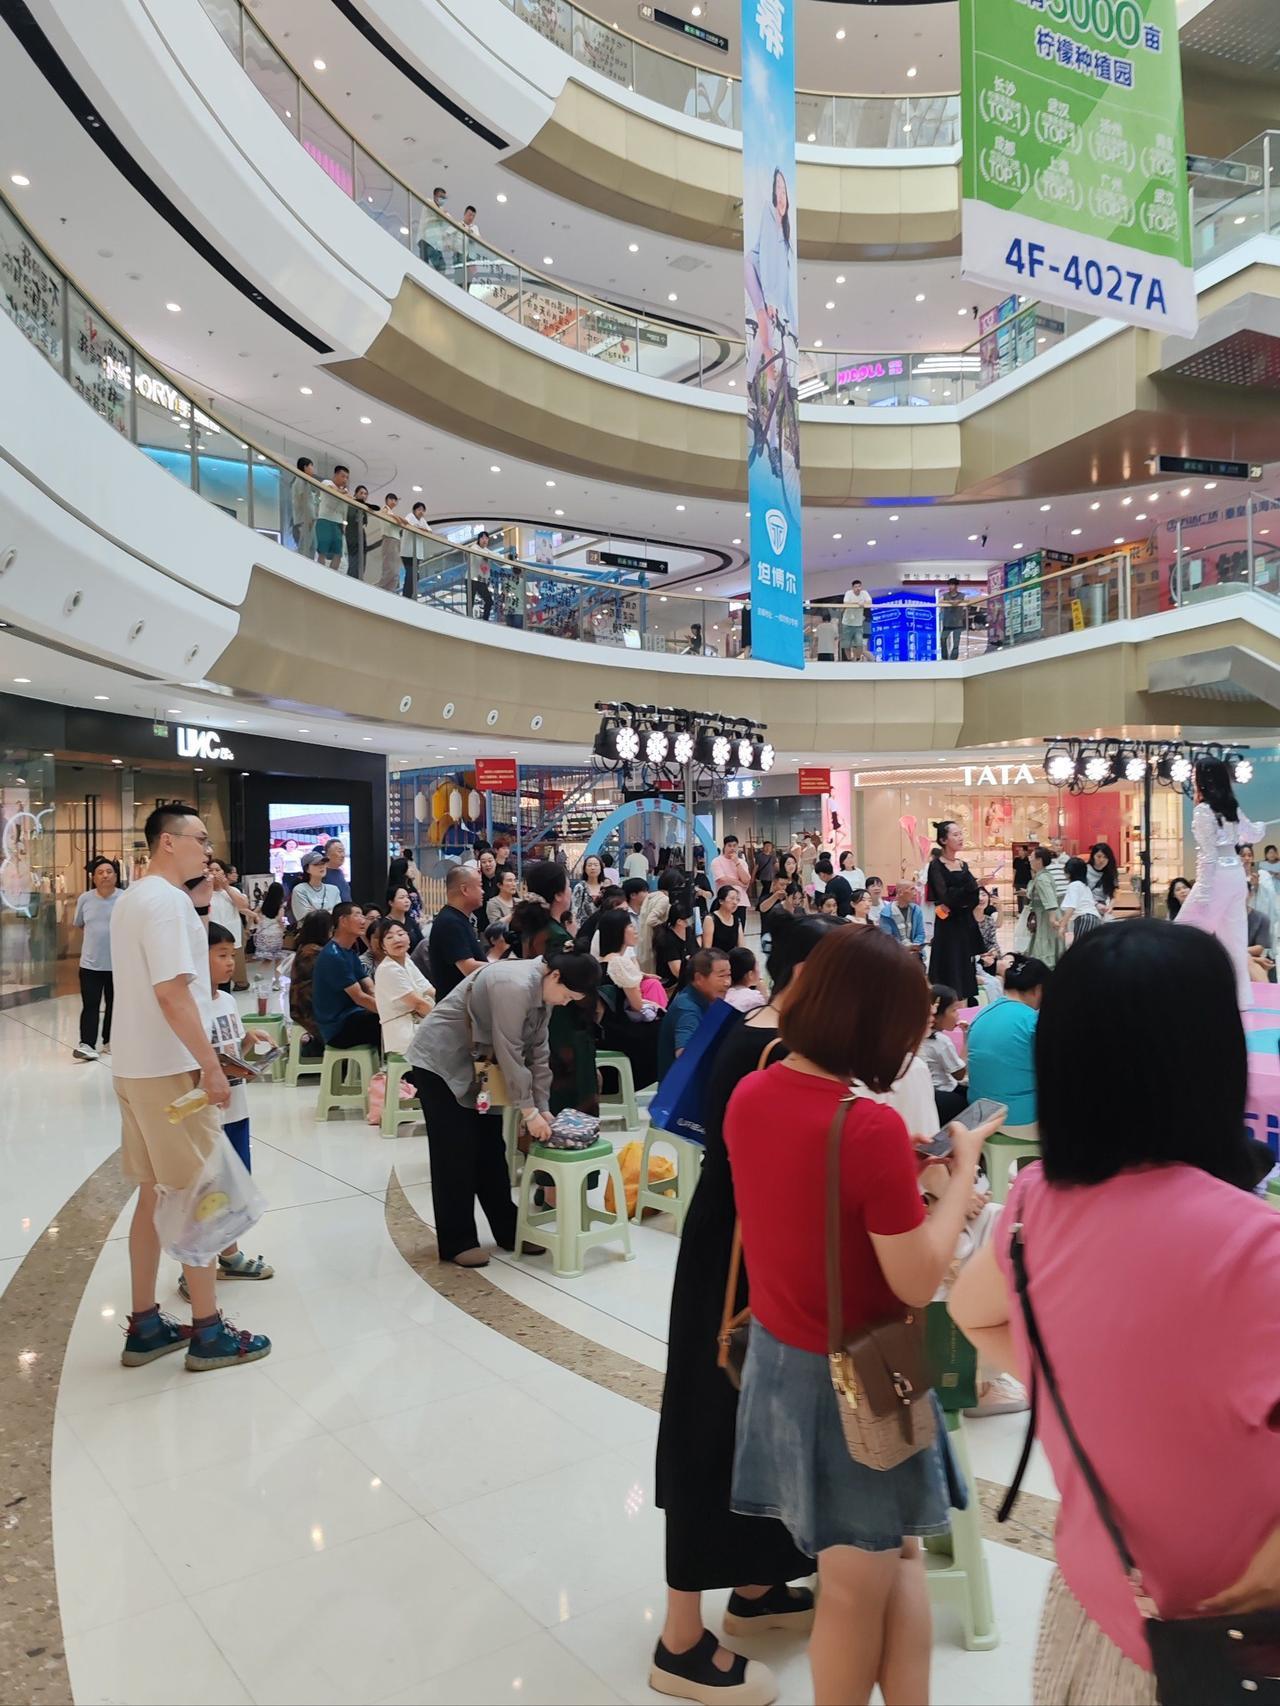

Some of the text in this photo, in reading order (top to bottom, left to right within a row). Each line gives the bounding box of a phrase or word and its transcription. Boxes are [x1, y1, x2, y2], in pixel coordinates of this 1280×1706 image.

[1036, 28, 1133, 88] 柠檬种植园
[1005, 238, 1167, 314] 4F-4027A
[757, 561, 797, 594] 坦博尔
[960, 763, 1035, 786] TATA
